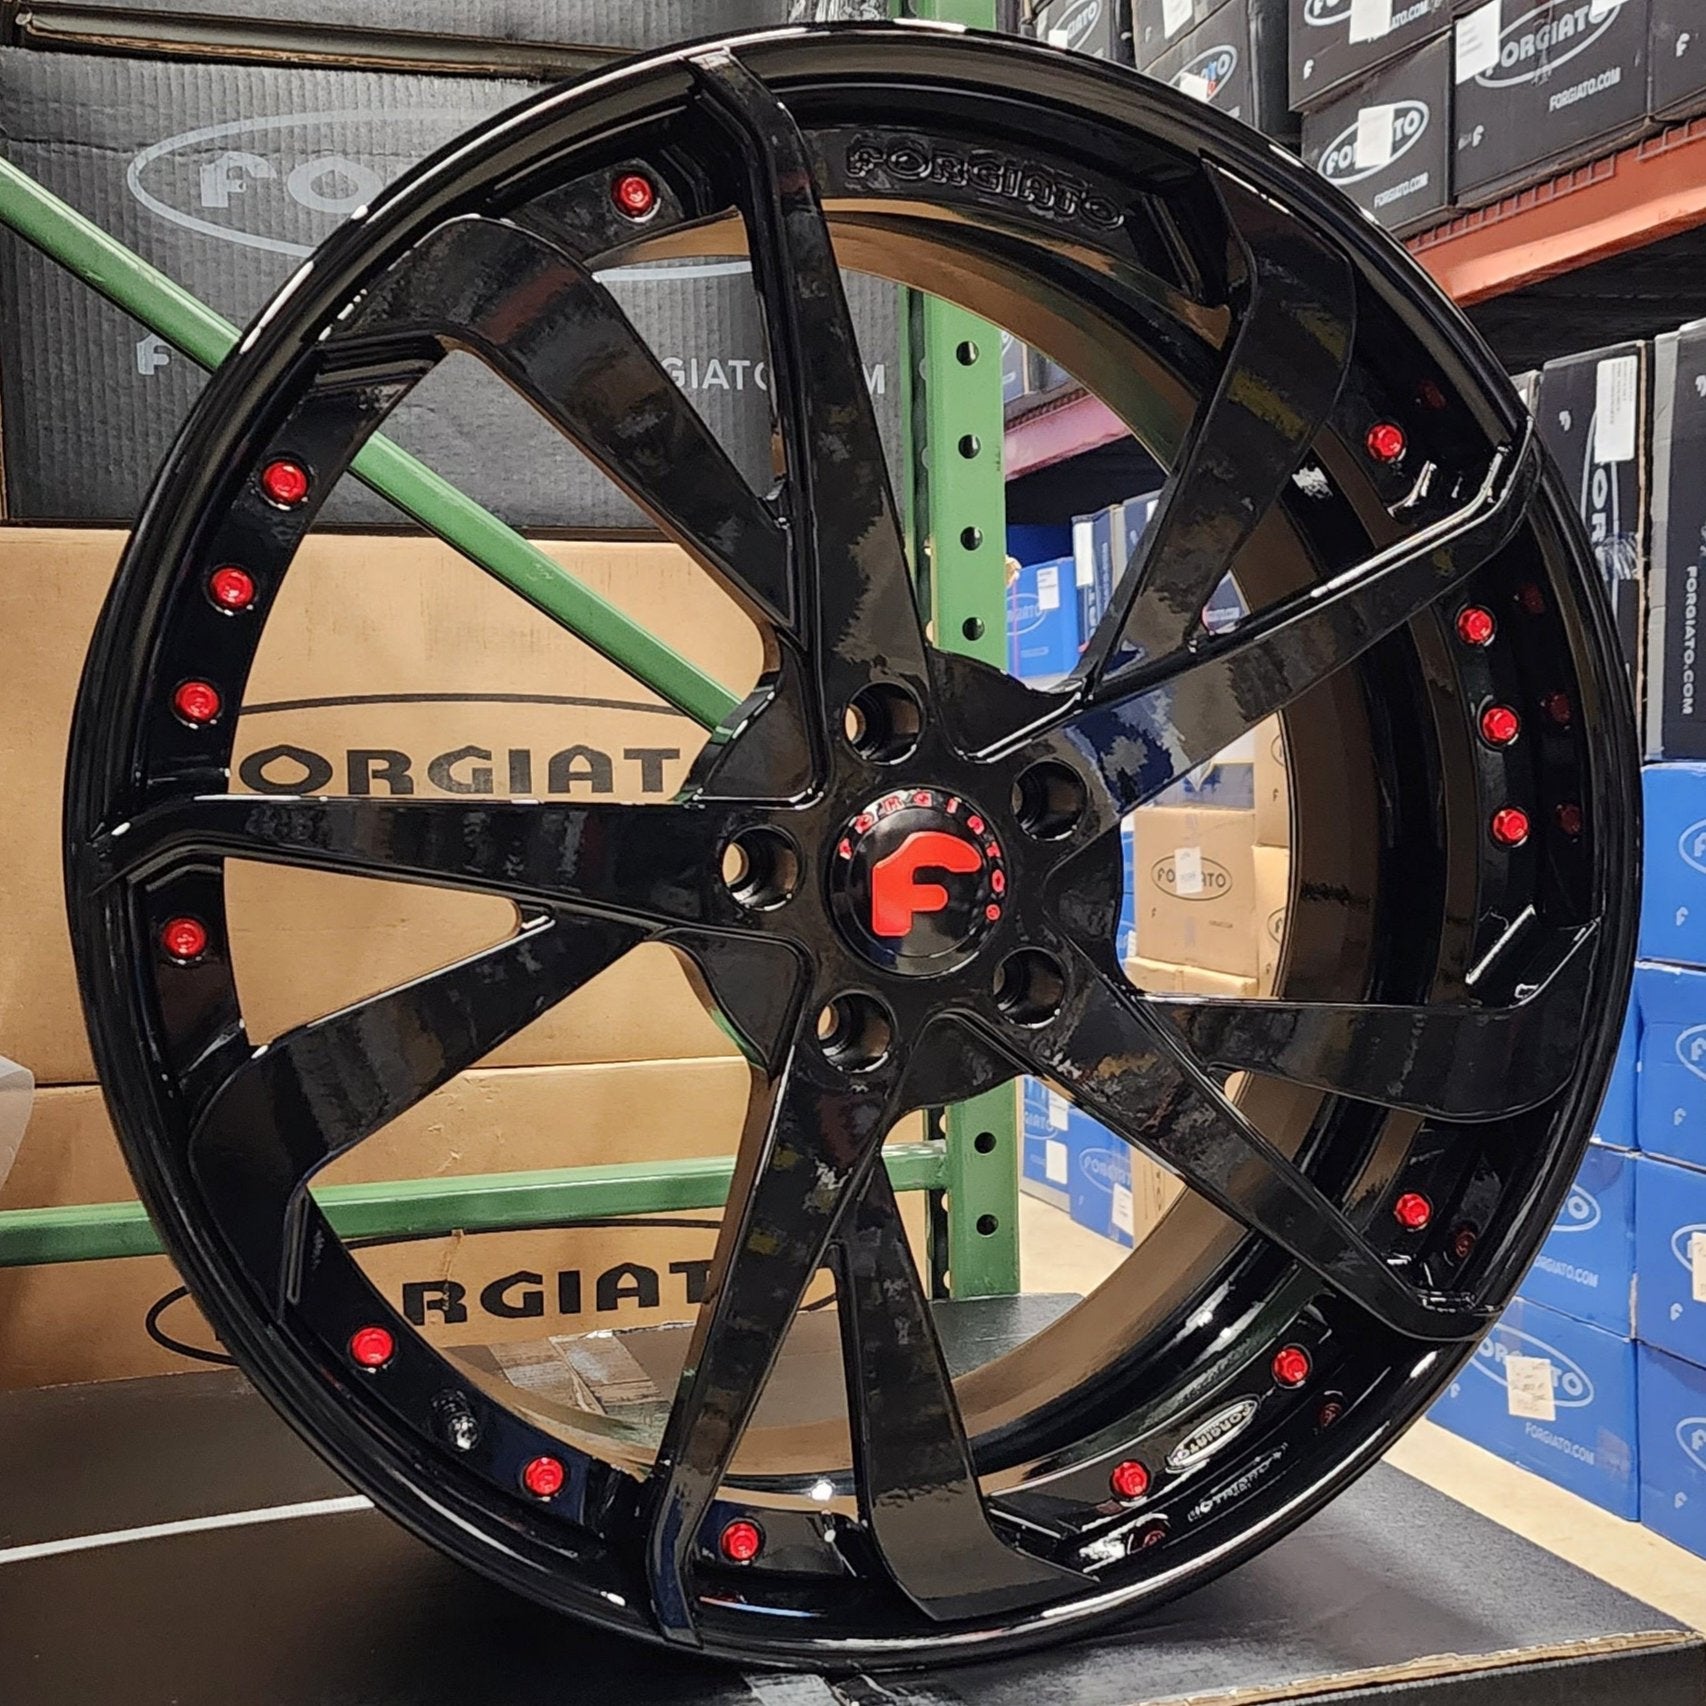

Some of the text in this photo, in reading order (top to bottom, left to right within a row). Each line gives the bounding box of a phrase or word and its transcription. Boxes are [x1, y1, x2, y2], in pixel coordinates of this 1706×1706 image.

[1549, 66, 1621, 112] FORGIATO.COM
[846, 135, 1125, 230] FORGIATO
[1682, 566, 1699, 714] FORGIATO.COM
[239, 744, 681, 795] ORGIAT
[403, 1259, 717, 1327] RGIAT
